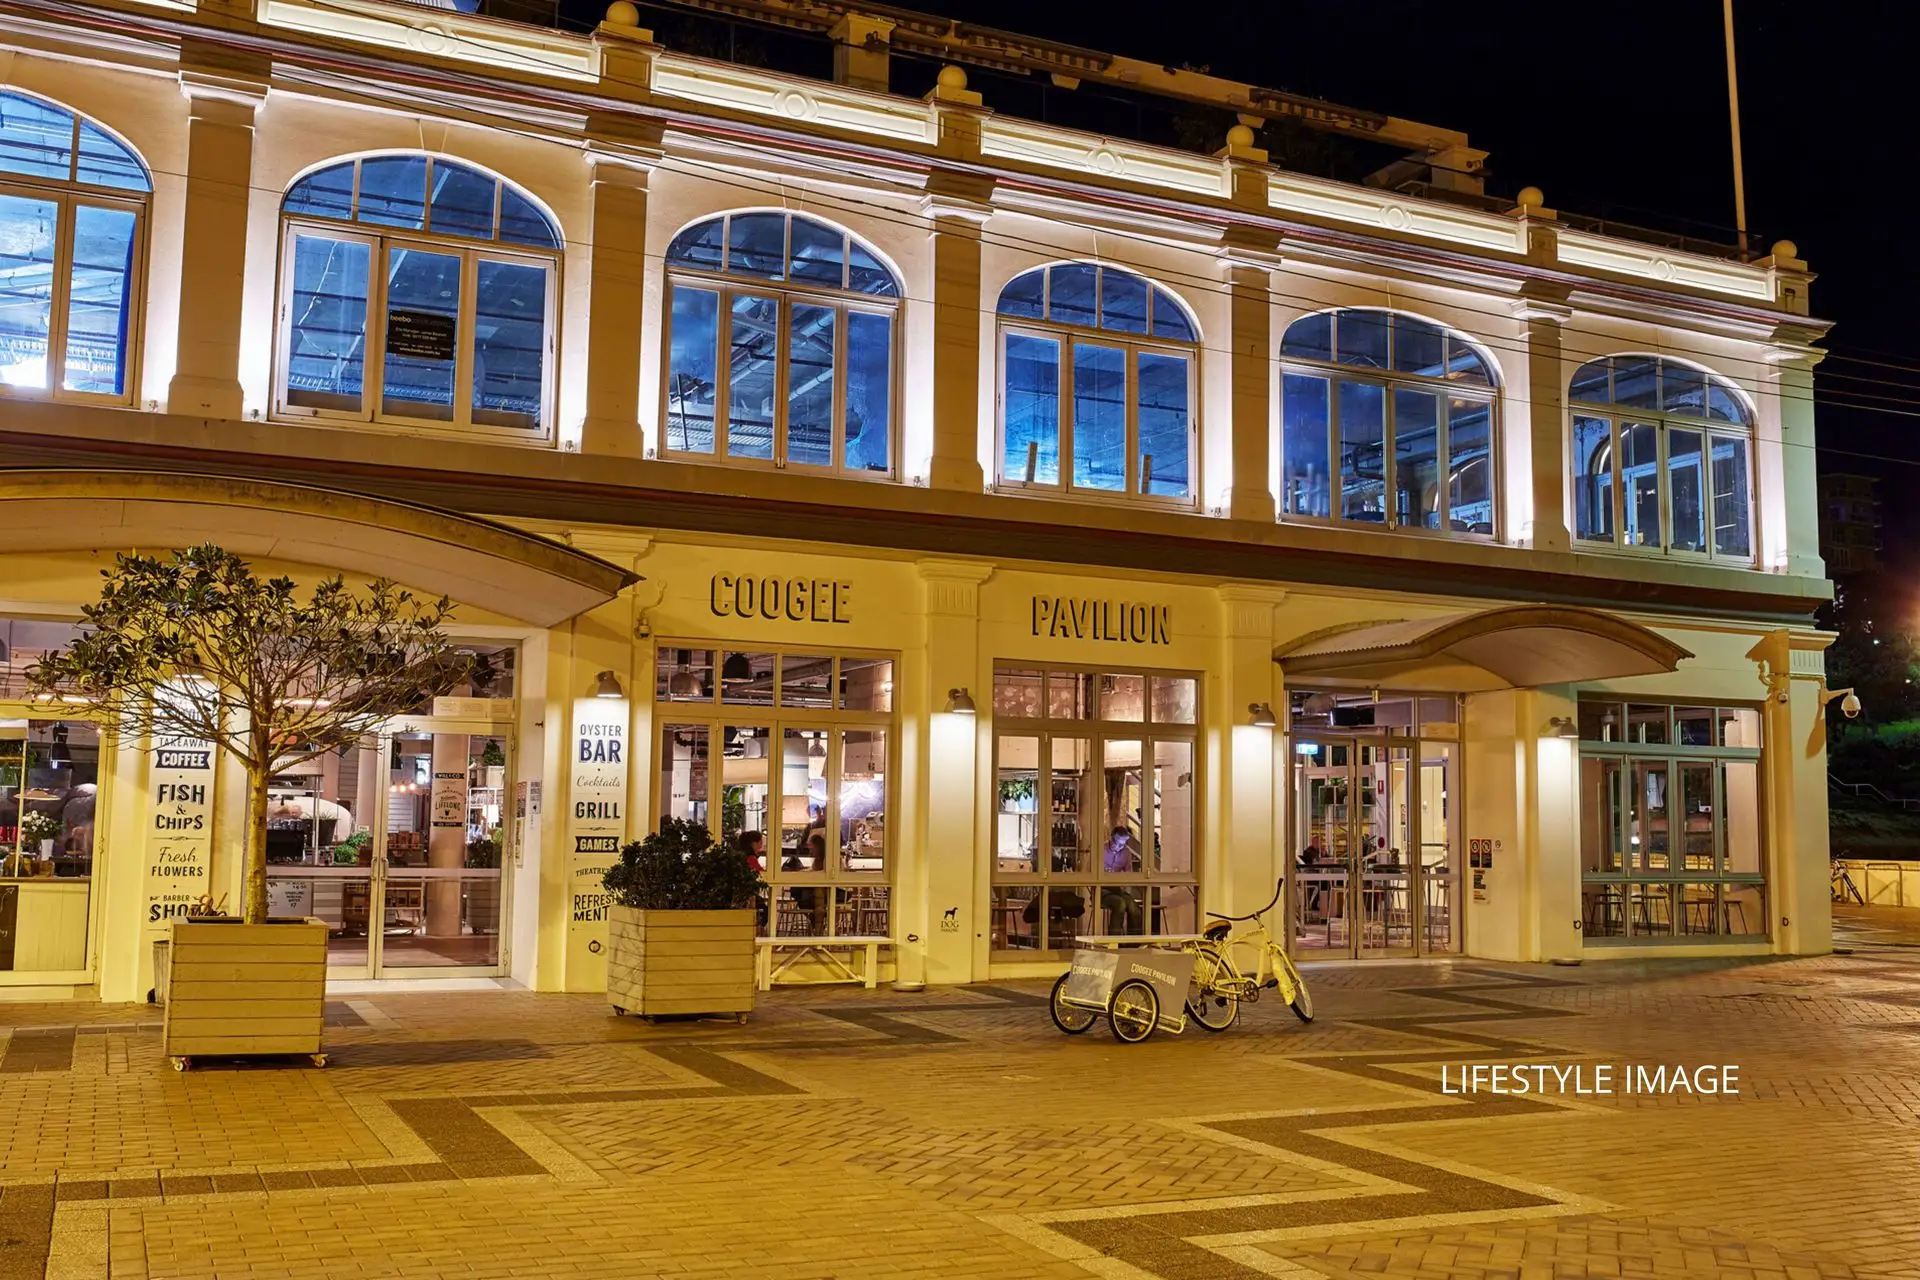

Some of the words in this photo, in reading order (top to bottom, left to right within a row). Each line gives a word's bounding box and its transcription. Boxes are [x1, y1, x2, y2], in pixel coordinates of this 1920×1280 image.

[710, 571, 853, 624] COOGEE
[1032, 595, 1172, 645] PAVILION
[580, 723, 622, 737] OYSTER
[160, 737, 209, 747] TAKEAWAY
[579, 738, 622, 764] BAR
[161, 752, 205, 767] COFFEE
[576, 775, 620, 788] Cocktails
[157, 784, 205, 806] FISH
[176, 804, 186, 815] &
[575, 802, 621, 819] GRILL
[156, 814, 203, 830] CHIPS
[579, 838, 615, 851] GAMES
[159, 846, 198, 863] Fresh
[151, 866, 203, 876] FLOWERS
[573, 905, 610, 921] MENT
[941, 920, 959, 928] DOG
[1073, 965, 1091, 975] COOGEE
[1131, 963, 1153, 977] COOGEE
[1153, 969, 1177, 987] PAVILION
